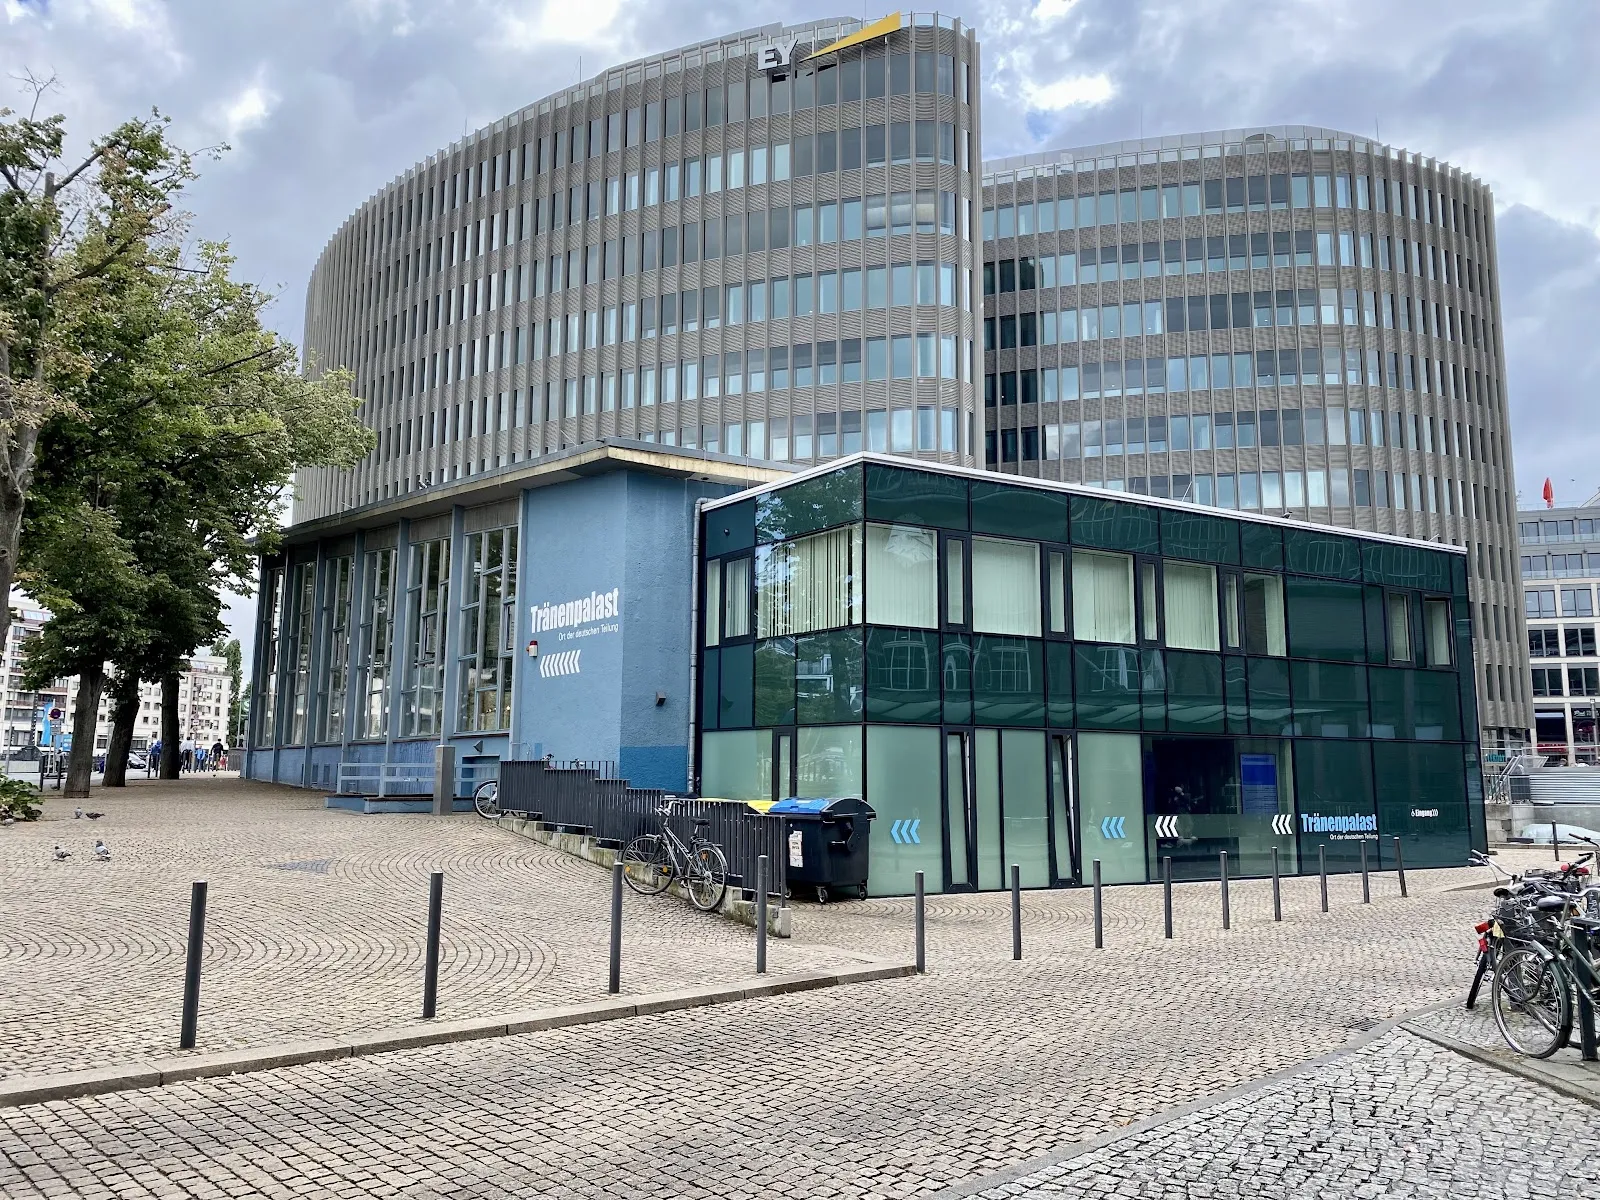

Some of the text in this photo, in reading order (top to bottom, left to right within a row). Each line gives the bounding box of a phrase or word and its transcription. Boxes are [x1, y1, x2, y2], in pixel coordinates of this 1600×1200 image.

[757, 38, 798, 71] EY
[530, 587, 619, 633] Tränenpalast
[558, 623, 619, 641] Ort der deutschen Teilung
[1415, 808, 1433, 817] Eingang
[1300, 812, 1378, 833] Tränenpalast
[1364, 832, 1379, 840] Teilung
